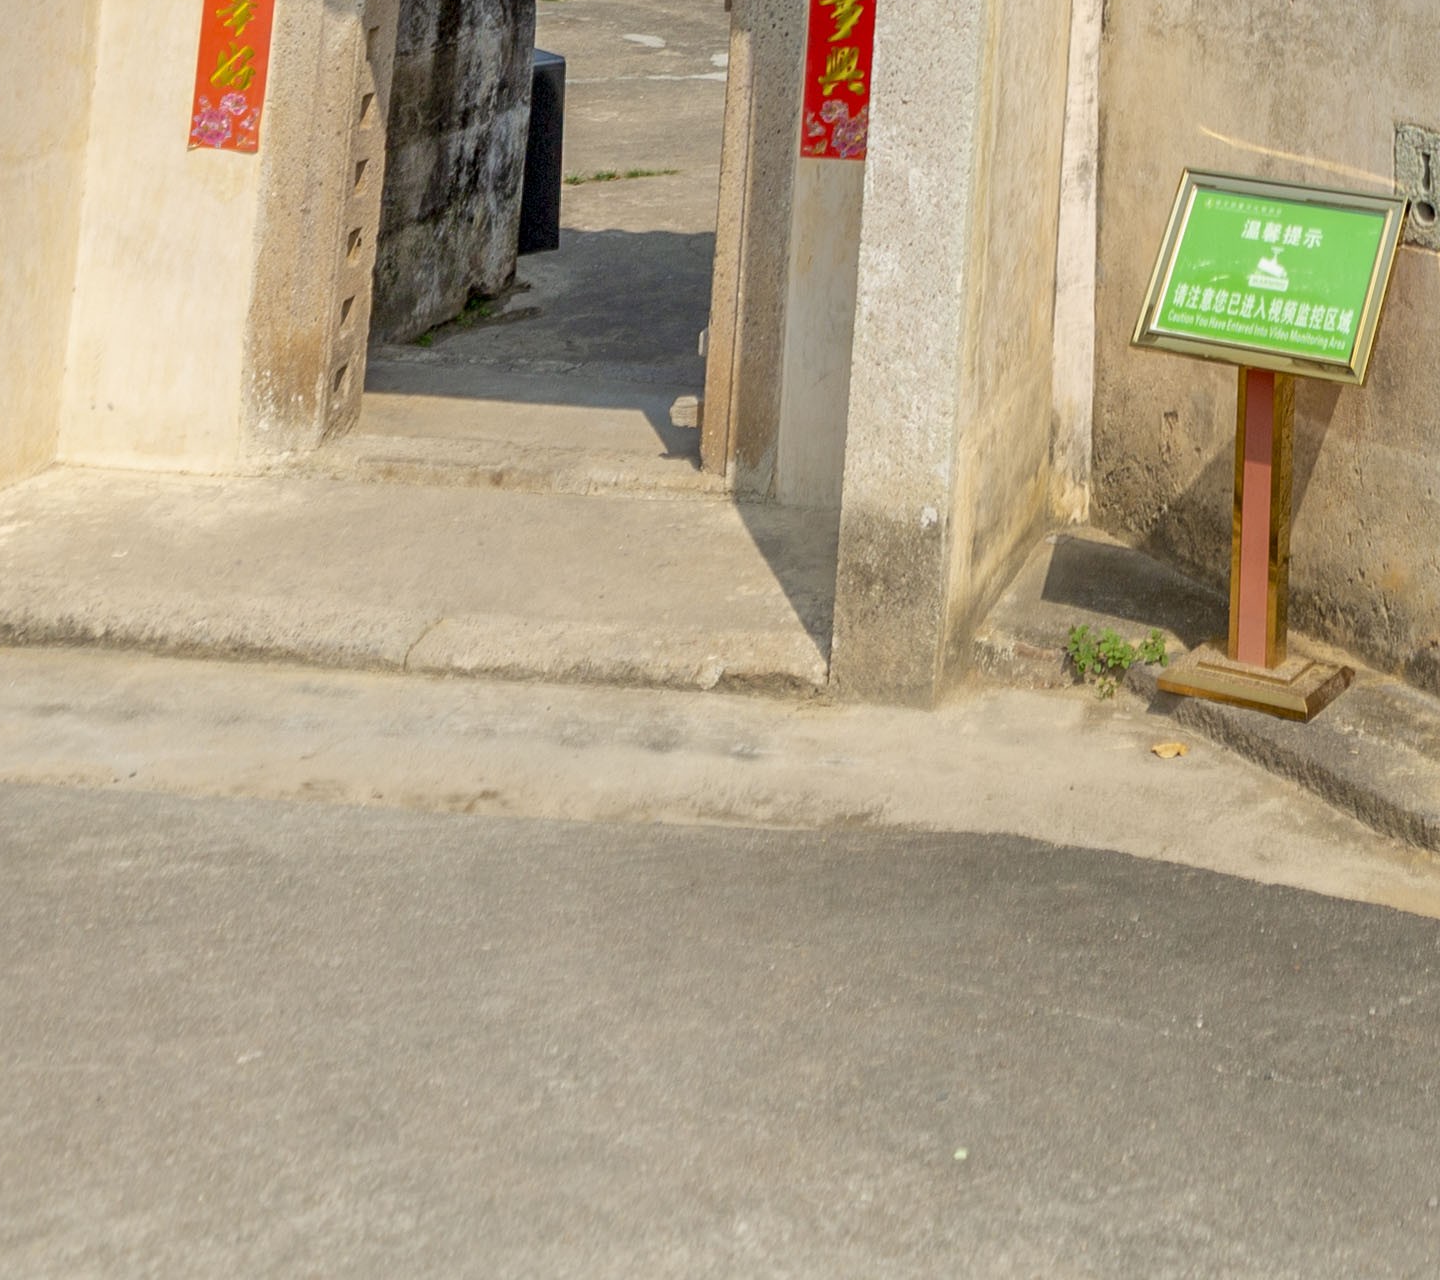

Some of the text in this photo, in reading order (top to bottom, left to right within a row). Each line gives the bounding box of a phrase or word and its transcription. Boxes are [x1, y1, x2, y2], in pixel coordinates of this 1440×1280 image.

[1241, 219, 1323, 249] 温馨提示
[1167, 309, 1195, 326] Caution
[1195, 313, 1209, 327] You
[1209, 316, 1226, 330] Have
[1226, 319, 1254, 336] Entered
[1269, 326, 1290, 341] Video
[1290, 330, 1328, 350] Monitoring
[1328, 337, 1346, 351] Area
[1173, 283, 1354, 335] 请注意您已进入视频监控区域
